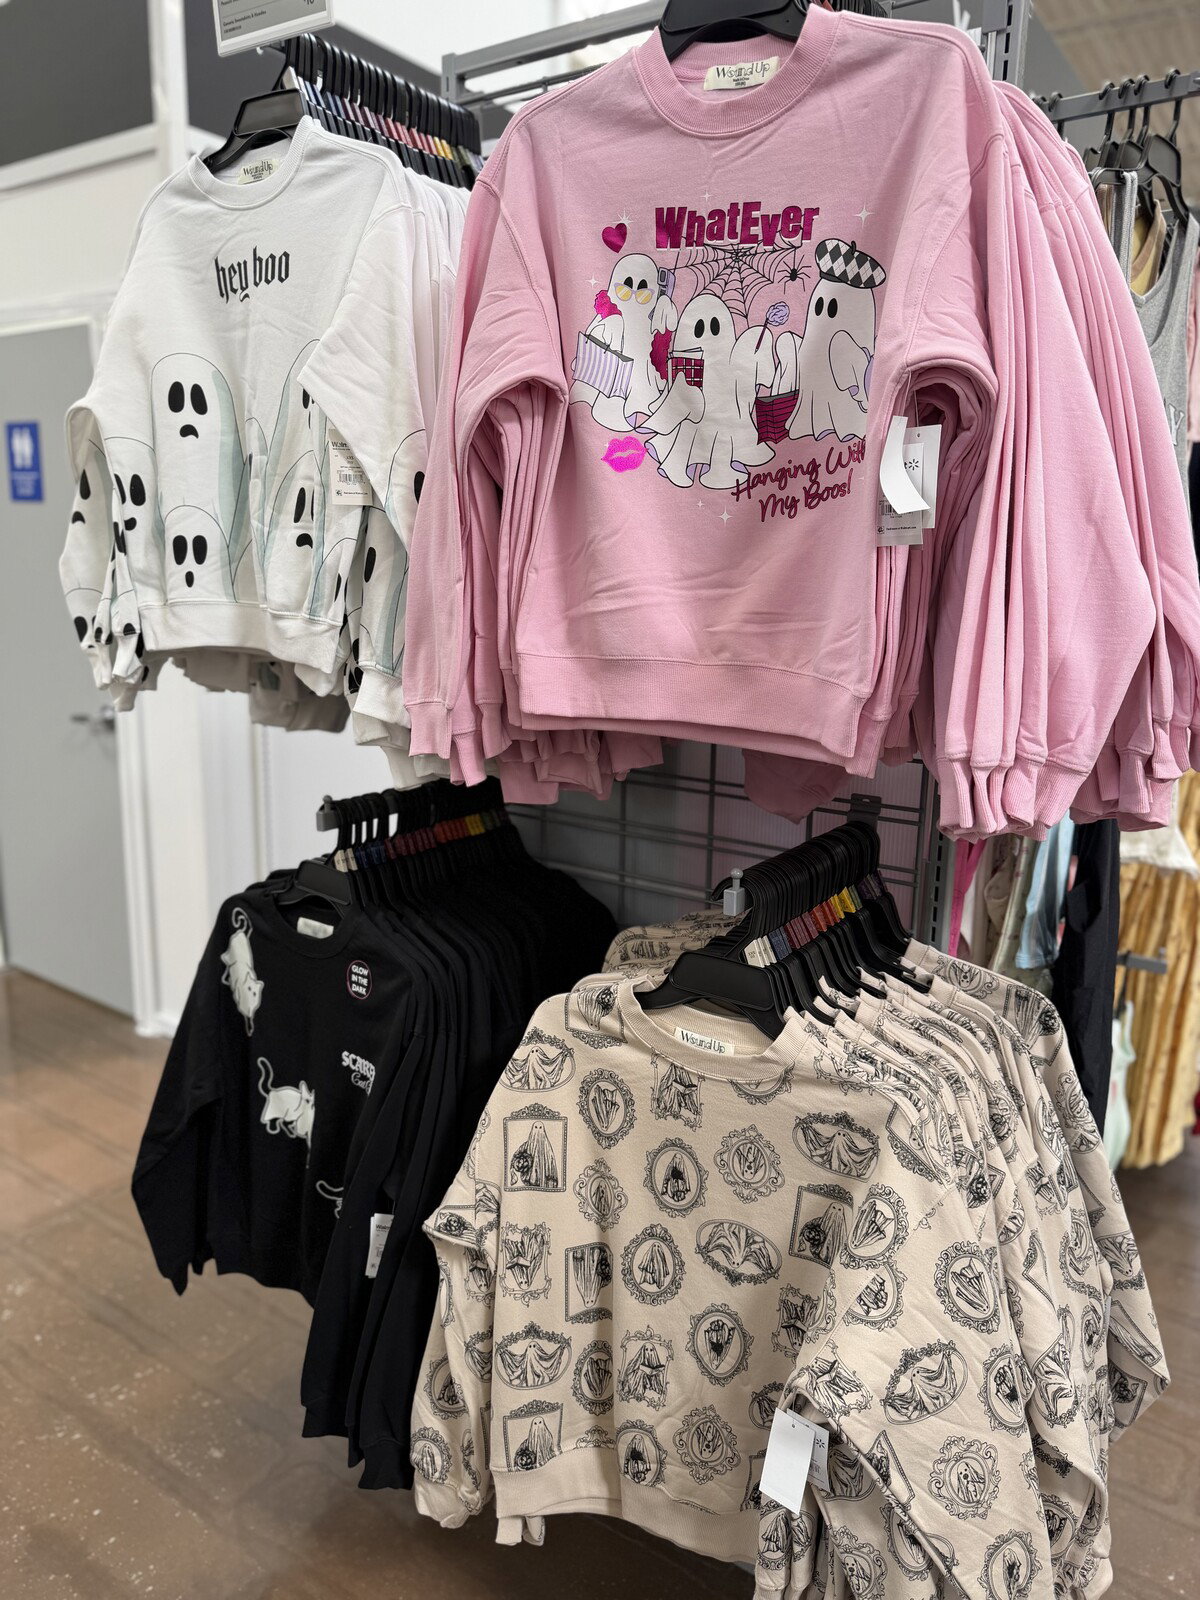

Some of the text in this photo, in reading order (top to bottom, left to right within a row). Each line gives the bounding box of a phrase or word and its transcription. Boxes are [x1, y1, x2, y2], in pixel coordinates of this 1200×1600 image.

[716, 61, 770, 78] Wound Up
[263, 161, 273, 175] Up
[655, 201, 820, 250] WhatEver
[214, 245, 290, 304] hey boo
[731, 458, 821, 502] Hanging
[759, 468, 853, 522] My Boos!
[351, 964, 369, 976] GLOW
[351, 974, 368, 986] IN THE
[351, 983, 367, 996] DARK
[681, 1030, 726, 1054] Wound Up
